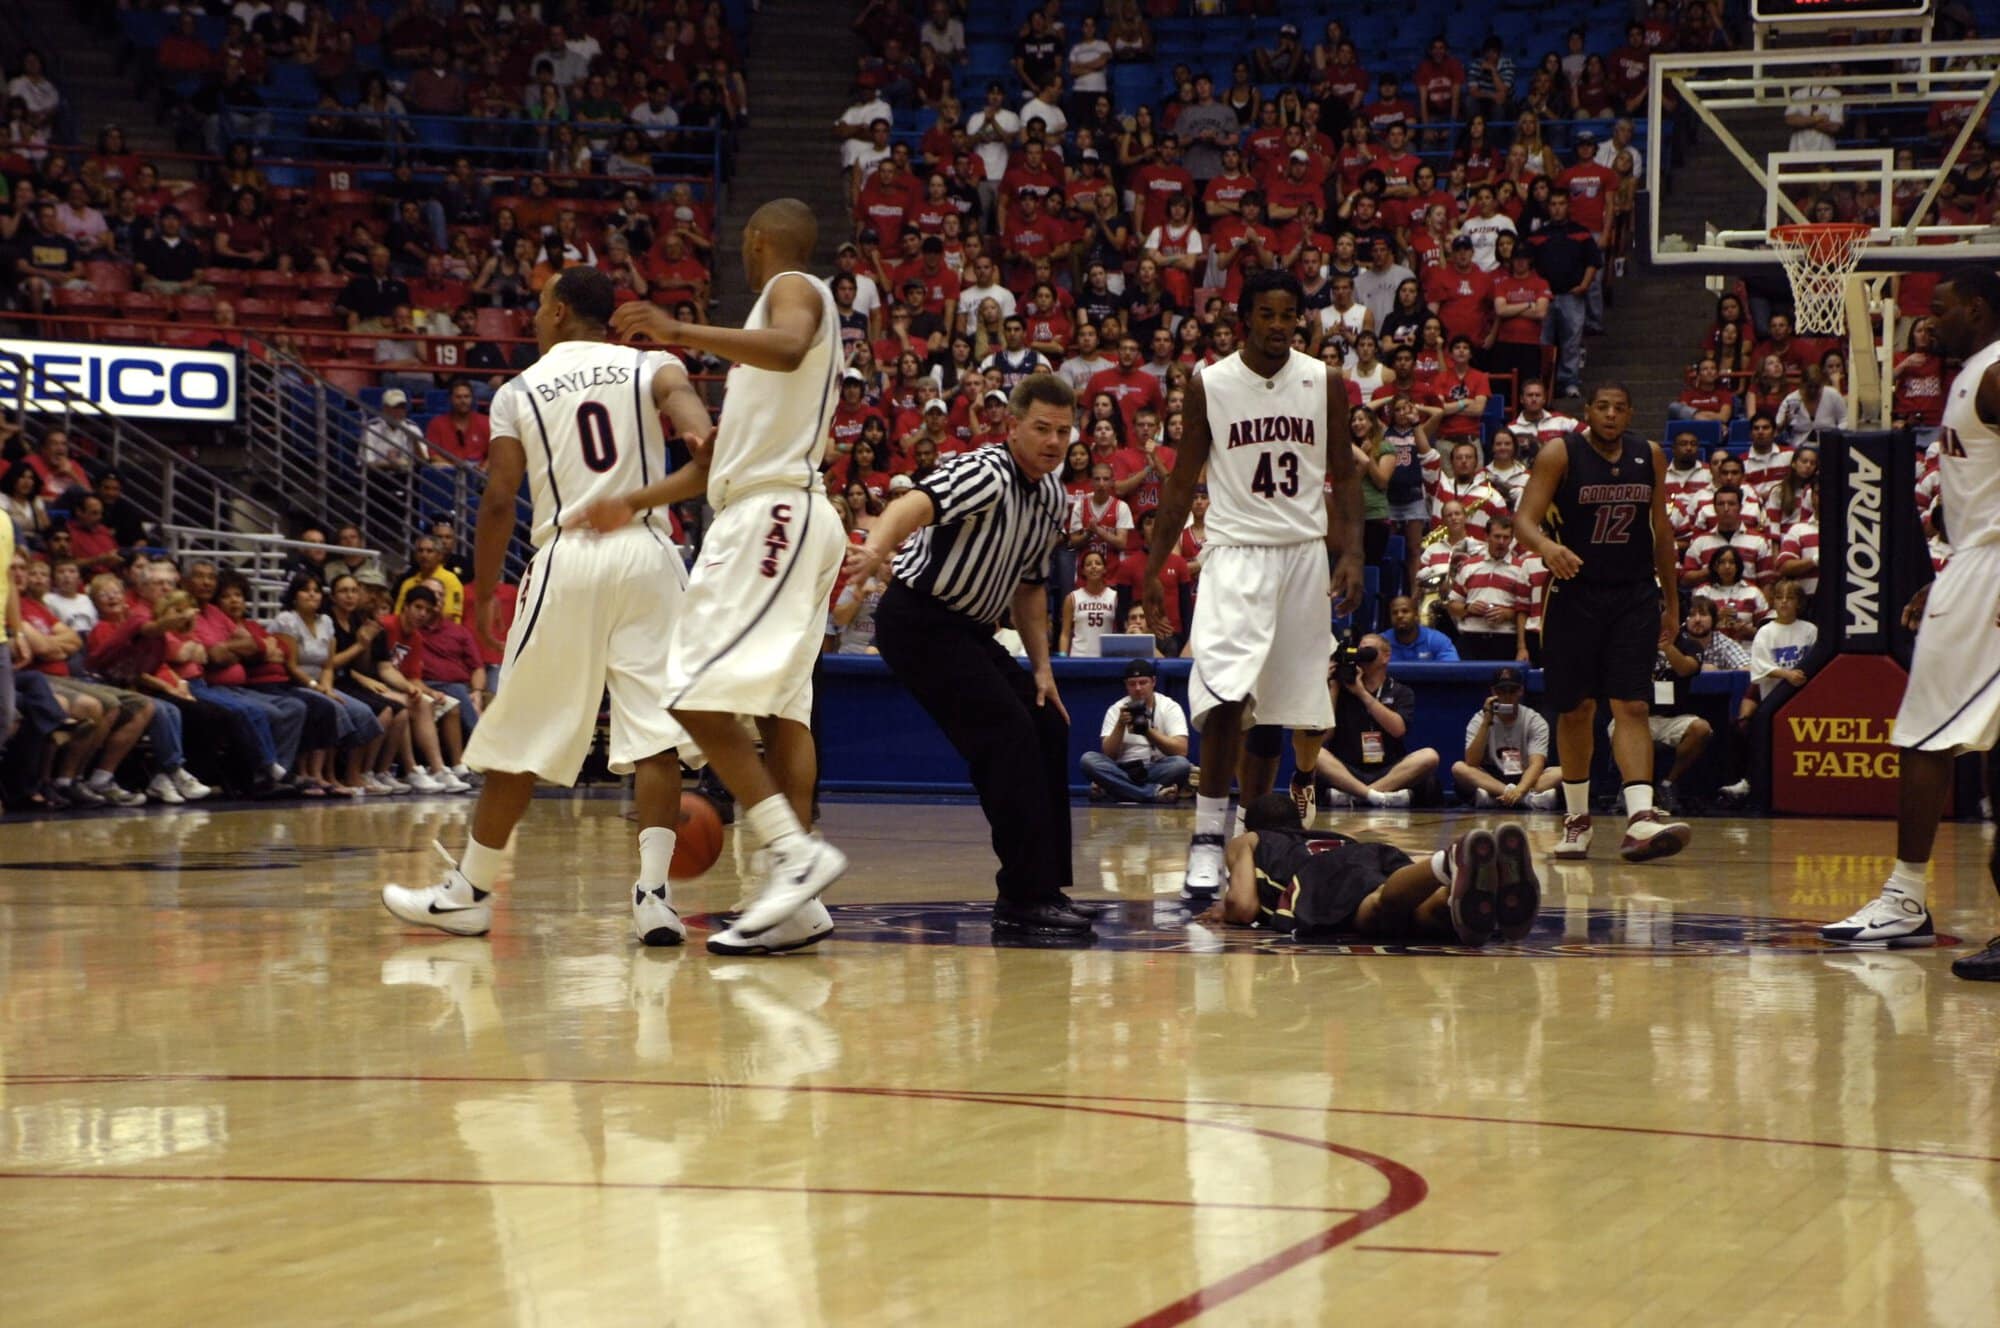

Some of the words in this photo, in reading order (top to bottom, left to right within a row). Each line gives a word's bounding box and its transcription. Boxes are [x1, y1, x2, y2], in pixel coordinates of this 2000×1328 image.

[329, 171, 350, 191] 19
[435, 344, 458, 365] 19
[536, 366, 630, 402] BAYLESS
[576, 401, 618, 473] 0
[1227, 415, 1315, 450] ARIZONA
[1251, 451, 1298, 498] 43
[1138, 487, 1159, 506] 34
[760, 504, 792, 577] CATS
[1590, 503, 1637, 544] 12
[1845, 445, 1882, 634] ARIZONA
[1078, 602, 1113, 611] ARIZONA
[1088, 612, 1104, 627] 55
